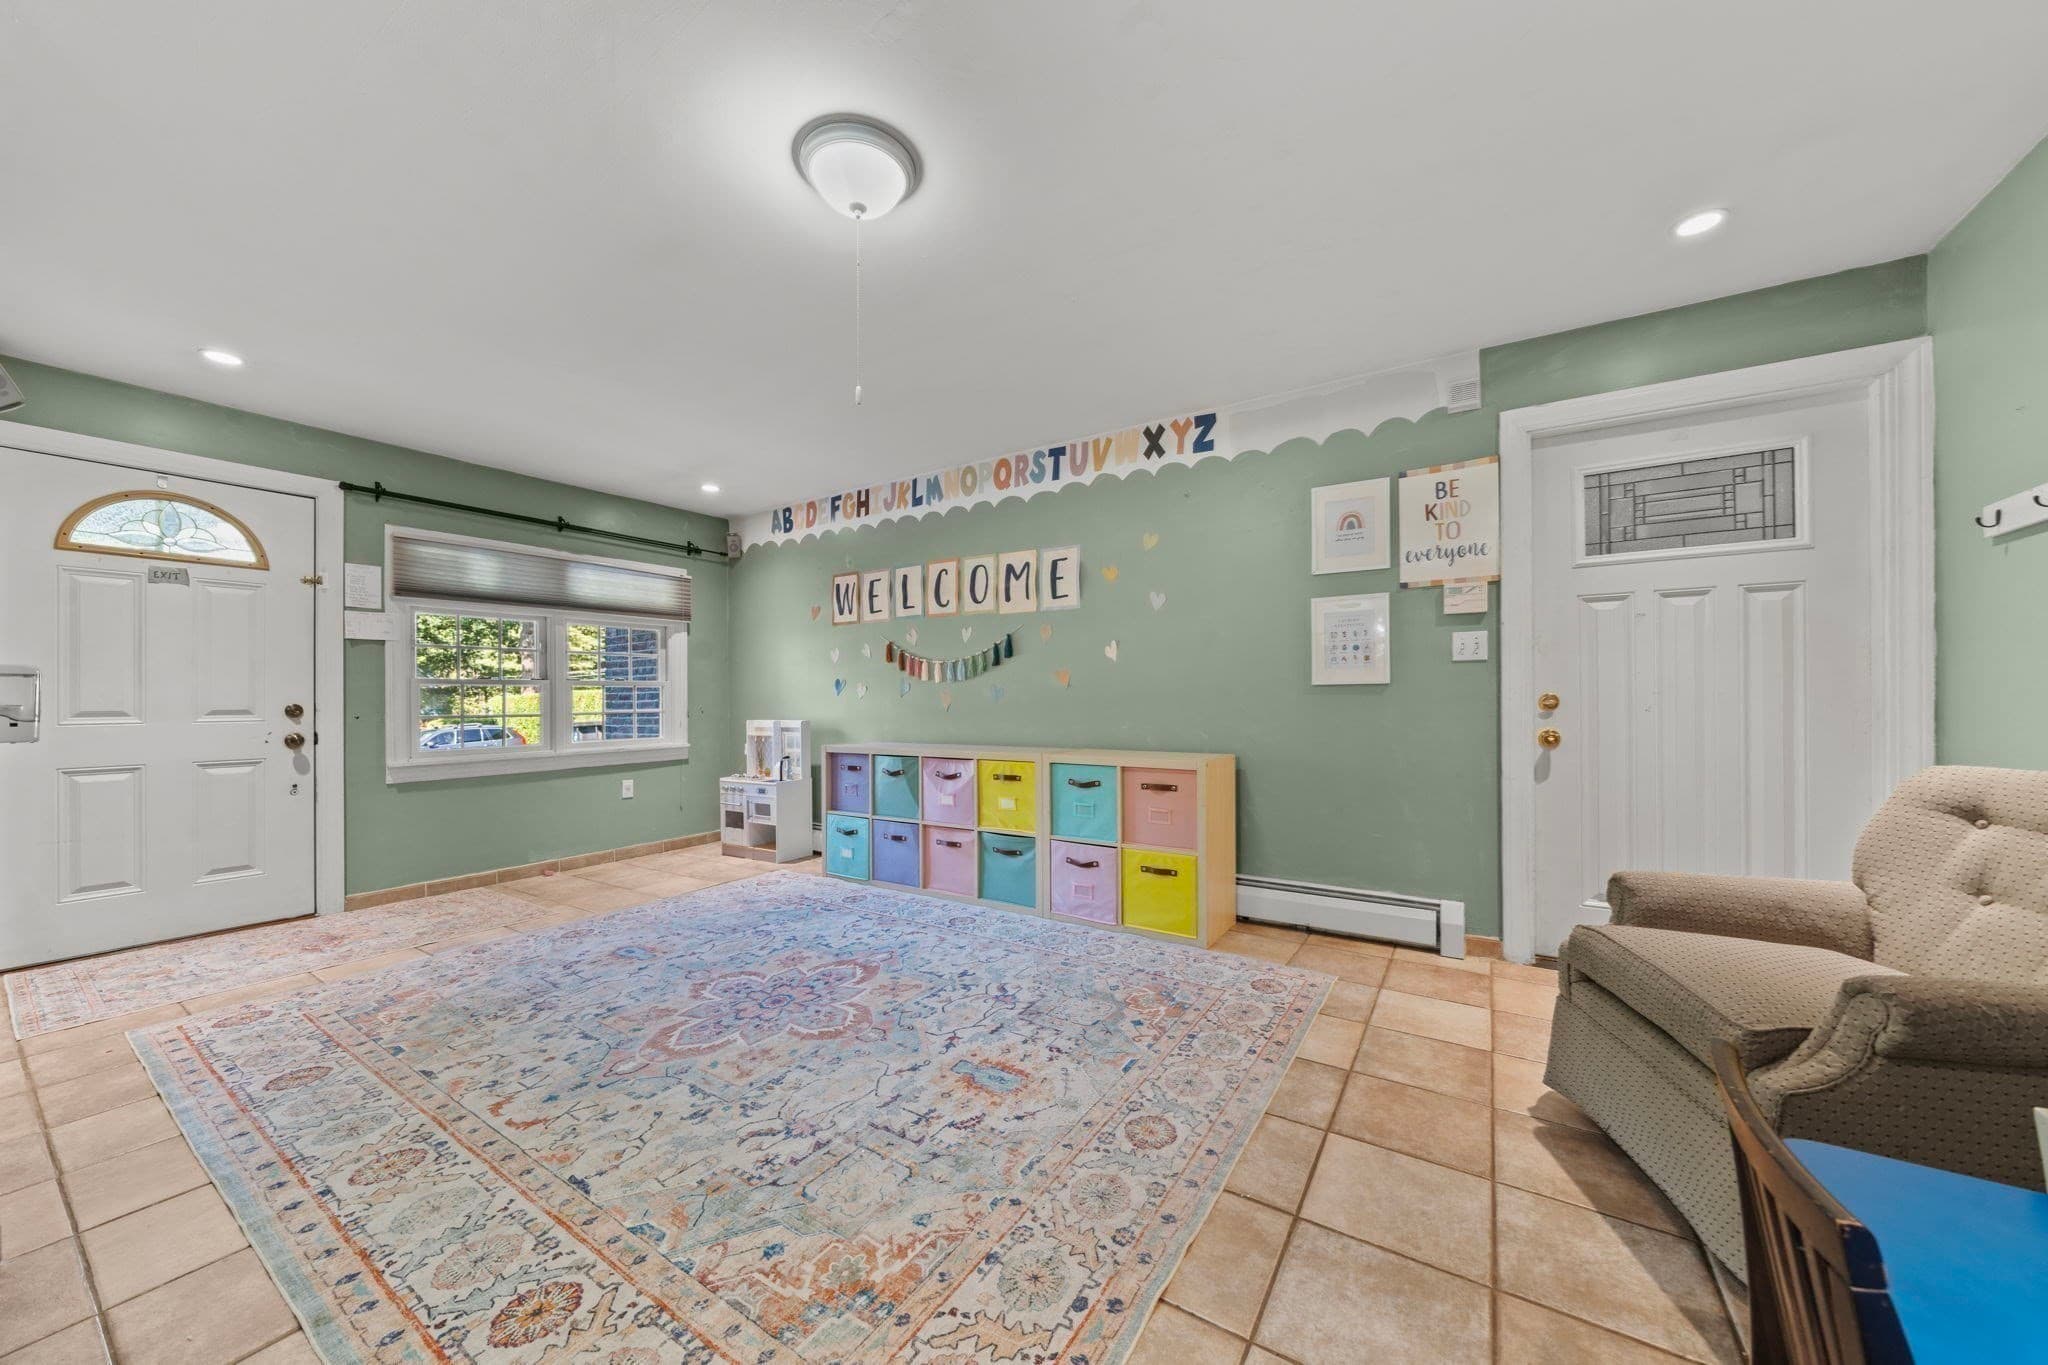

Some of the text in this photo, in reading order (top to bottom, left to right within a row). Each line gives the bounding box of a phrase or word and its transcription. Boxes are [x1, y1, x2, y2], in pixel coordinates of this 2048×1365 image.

[1435, 479, 1460, 500] BE
[1424, 500, 1471, 521] KIND
[1434, 521, 1461, 541] TO
[1405, 543, 1488, 567] everyone
[153, 570, 181, 580] EXIT
[835, 557, 1069, 616] WELCOME
